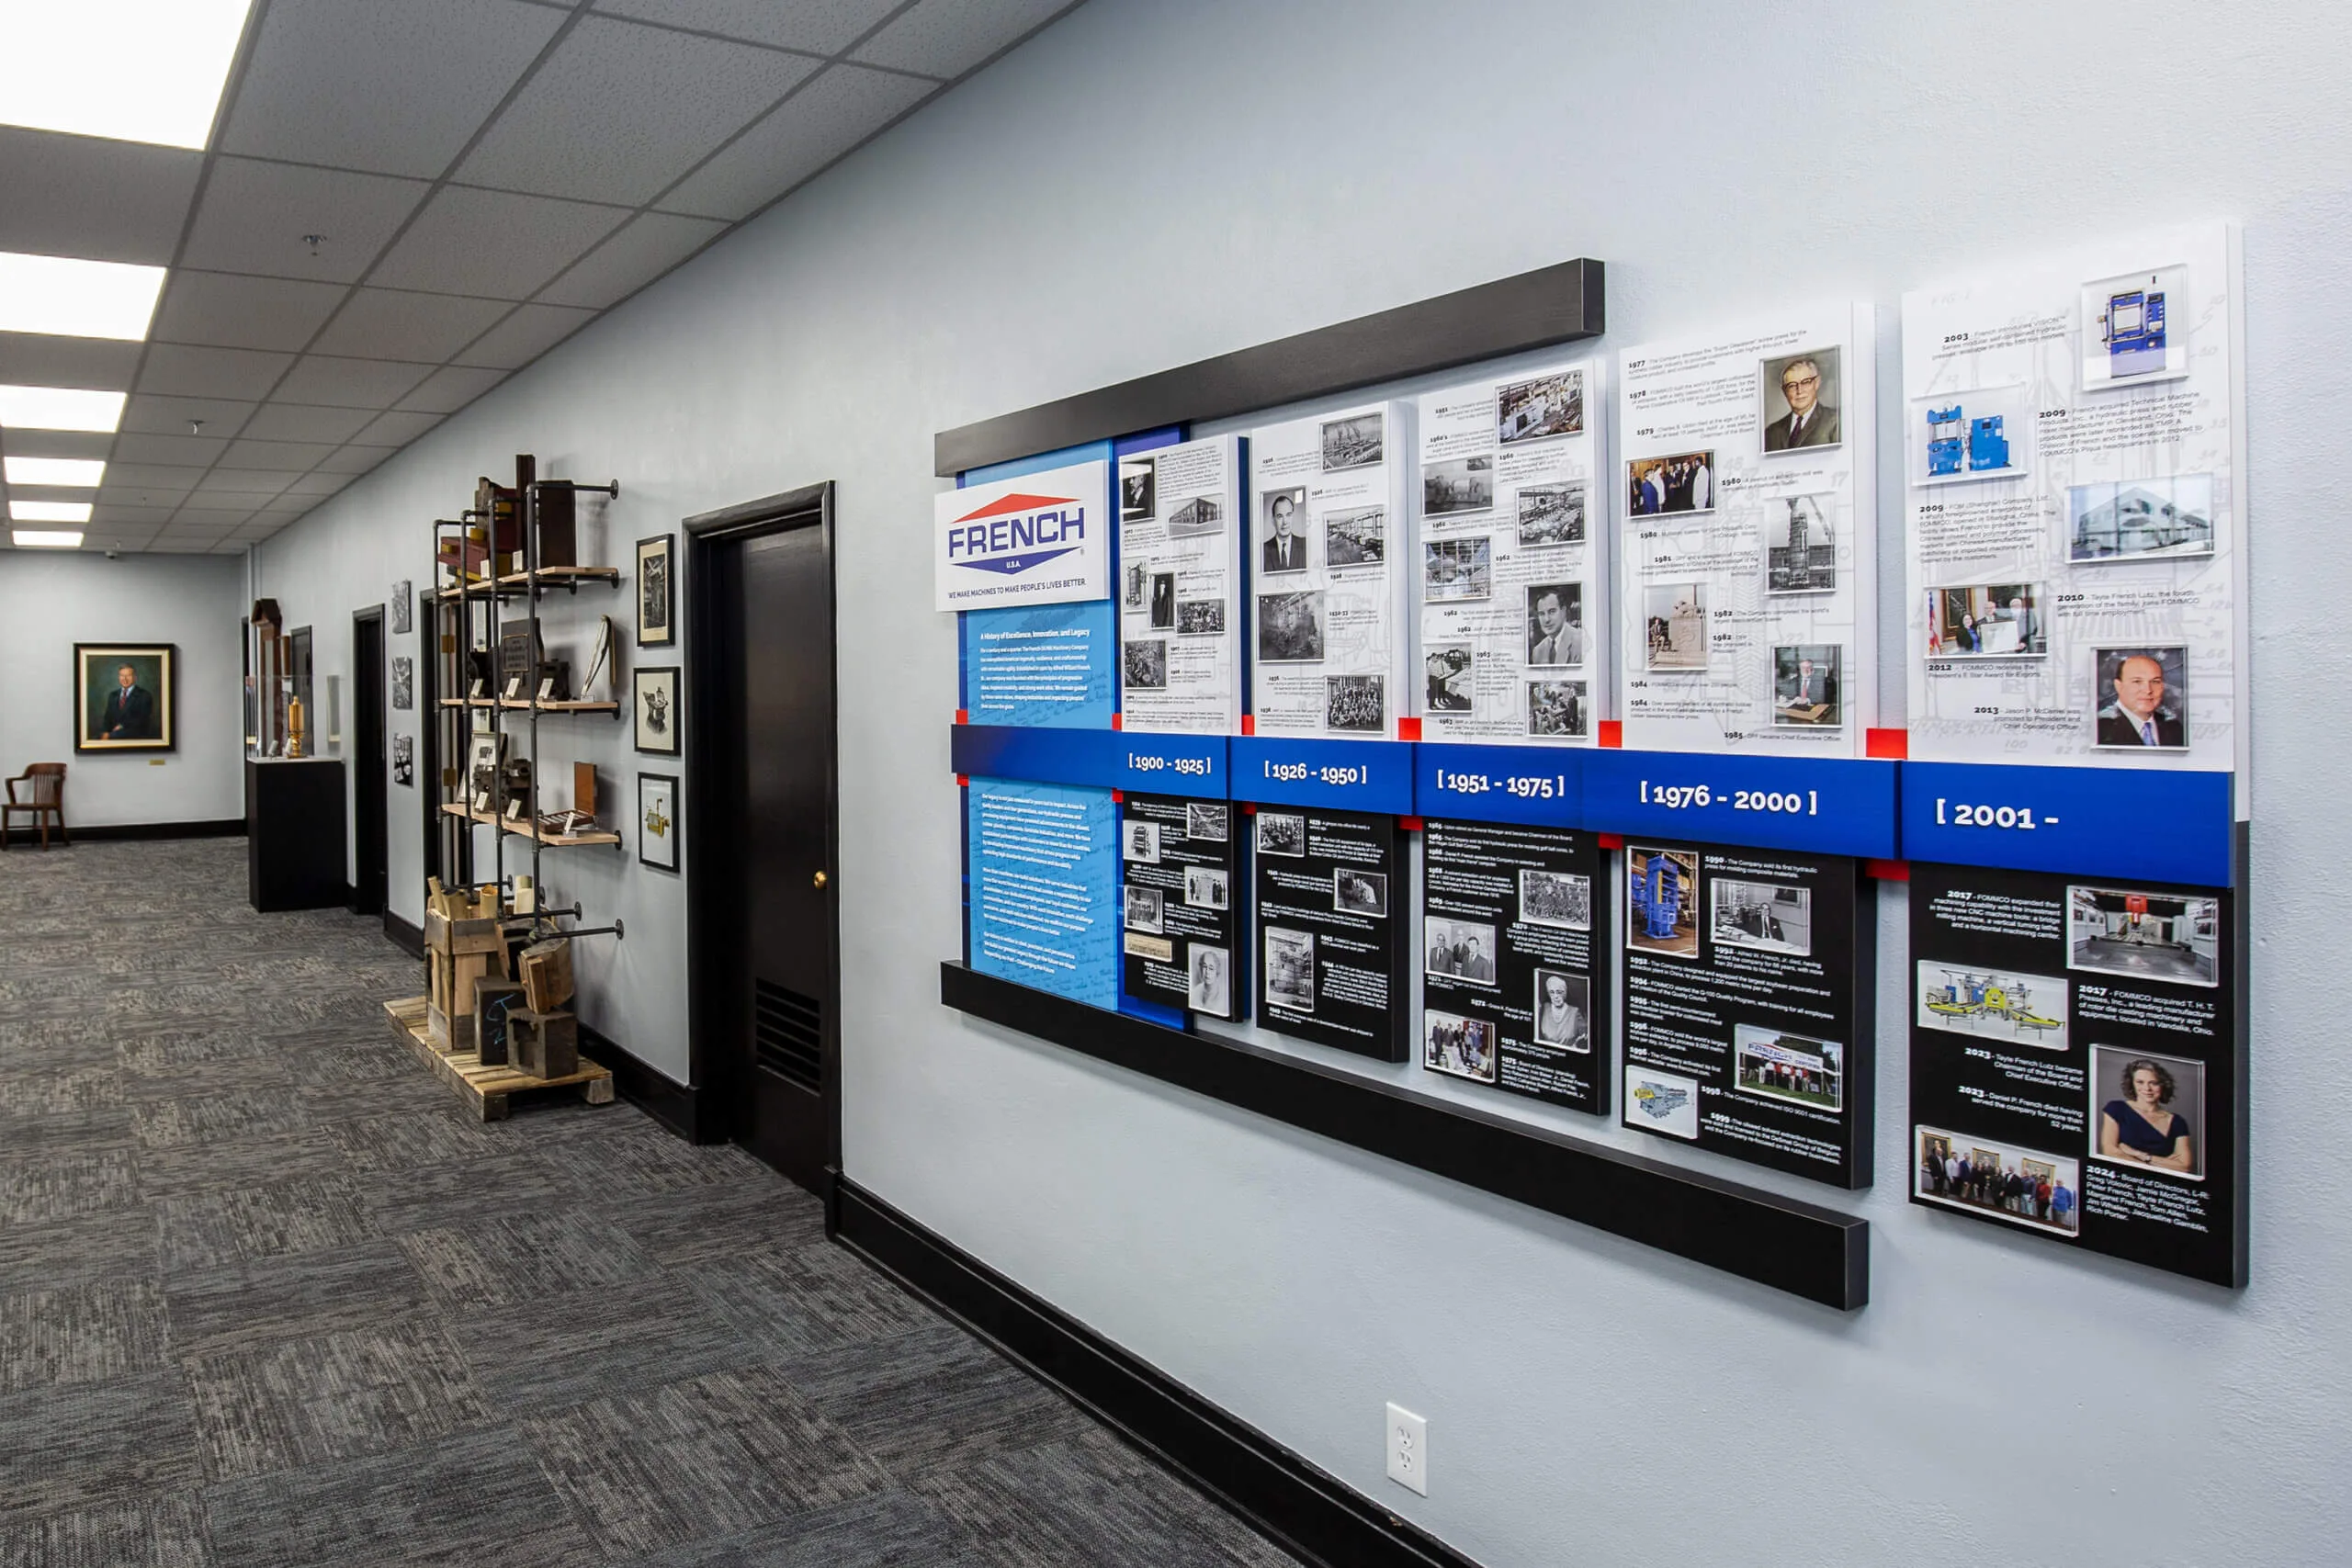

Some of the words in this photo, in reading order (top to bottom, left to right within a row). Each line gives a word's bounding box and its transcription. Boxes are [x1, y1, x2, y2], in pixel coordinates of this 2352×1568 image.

[1944, 333, 1969, 344] 2003
[1630, 360, 1645, 368] 1977
[1630, 389, 1646, 399] 1978
[2039, 409, 2066, 419] 2009
[1637, 428, 1654, 436] 1979
[1920, 504, 1944, 513] 2009
[948, 507, 1084, 558] FRENCH
[956, 590, 970, 598] MAKE
[970, 588, 996, 597] MACHINES
[1005, 585, 1020, 593] MAKE
[1020, 582, 1046, 592] PEOPLE'S
[1046, 581, 1062, 590] LIVES
[1063, 579, 1087, 588] BETTER.
[984, 633, 1000, 641] History
[1071, 629, 1090, 637] Legacy
[1973, 707, 1999, 716] 2013
[1135, 756, 1163, 772] 1900
[1174, 758, 1204, 775] 1925
[1272, 762, 1307, 783] 1926
[1320, 767, 1358, 785] 1950
[1446, 773, 1490, 794] 1951
[1506, 775, 1553, 799] 1975
[1653, 784, 1711, 809] 1976
[1734, 790, 1802, 813] 2000
[1954, 805, 2036, 829] 2001
[1948, 891, 1973, 900] 2017
[1977, 895, 2010, 904] FOMMCO
[2079, 985, 2109, 997] 2017
[2114, 990, 2152, 1003] FOMMCO
[2153, 996, 2186, 1008] acquired
[2079, 994, 2110, 1005] Presses,
[2134, 1002, 2163, 1013] leading
[2163, 1006, 2216, 1020] manufacturer
[1964, 1047, 1992, 1060] 2023
[2015, 1057, 2039, 1067] French
[2039, 1062, 2055, 1071] Lutz
[2055, 1064, 2084, 1076] became
[1994, 1062, 2027, 1073] Chairman
[2035, 1068, 2047, 1077] the
[2047, 1070, 2069, 1081] Board
[2069, 1074, 2084, 1084] and
[2006, 1071, 2024, 1080] Chief
[2025, 1075, 2057, 1087] Executive
[1958, 1086, 1985, 1099] 2023
[1989, 1092, 2010, 1102] Daniel
[2018, 1098, 2042, 1109] French
[2043, 1103, 2059, 1112] died
[2060, 1106, 2084, 1118] having
[2086, 1165, 2117, 1179] 2024
[2120, 1174, 2144, 1185] Board
[2154, 1181, 2190, 1197] Directors,
[2086, 1174, 2105, 1186] Greg
[2136, 1187, 2158, 1196] Jamie
[2086, 1181, 2107, 1191] Peter
[2157, 1198, 2185, 1210] French
[2086, 1190, 2119, 1203] Margaret
[2150, 1204, 2166, 1213] Tom
[2086, 1205, 2103, 1213] Rich
[2086, 1198, 2100, 1206] Jim
[2132, 1210, 2172, 1224] Jacqueline
